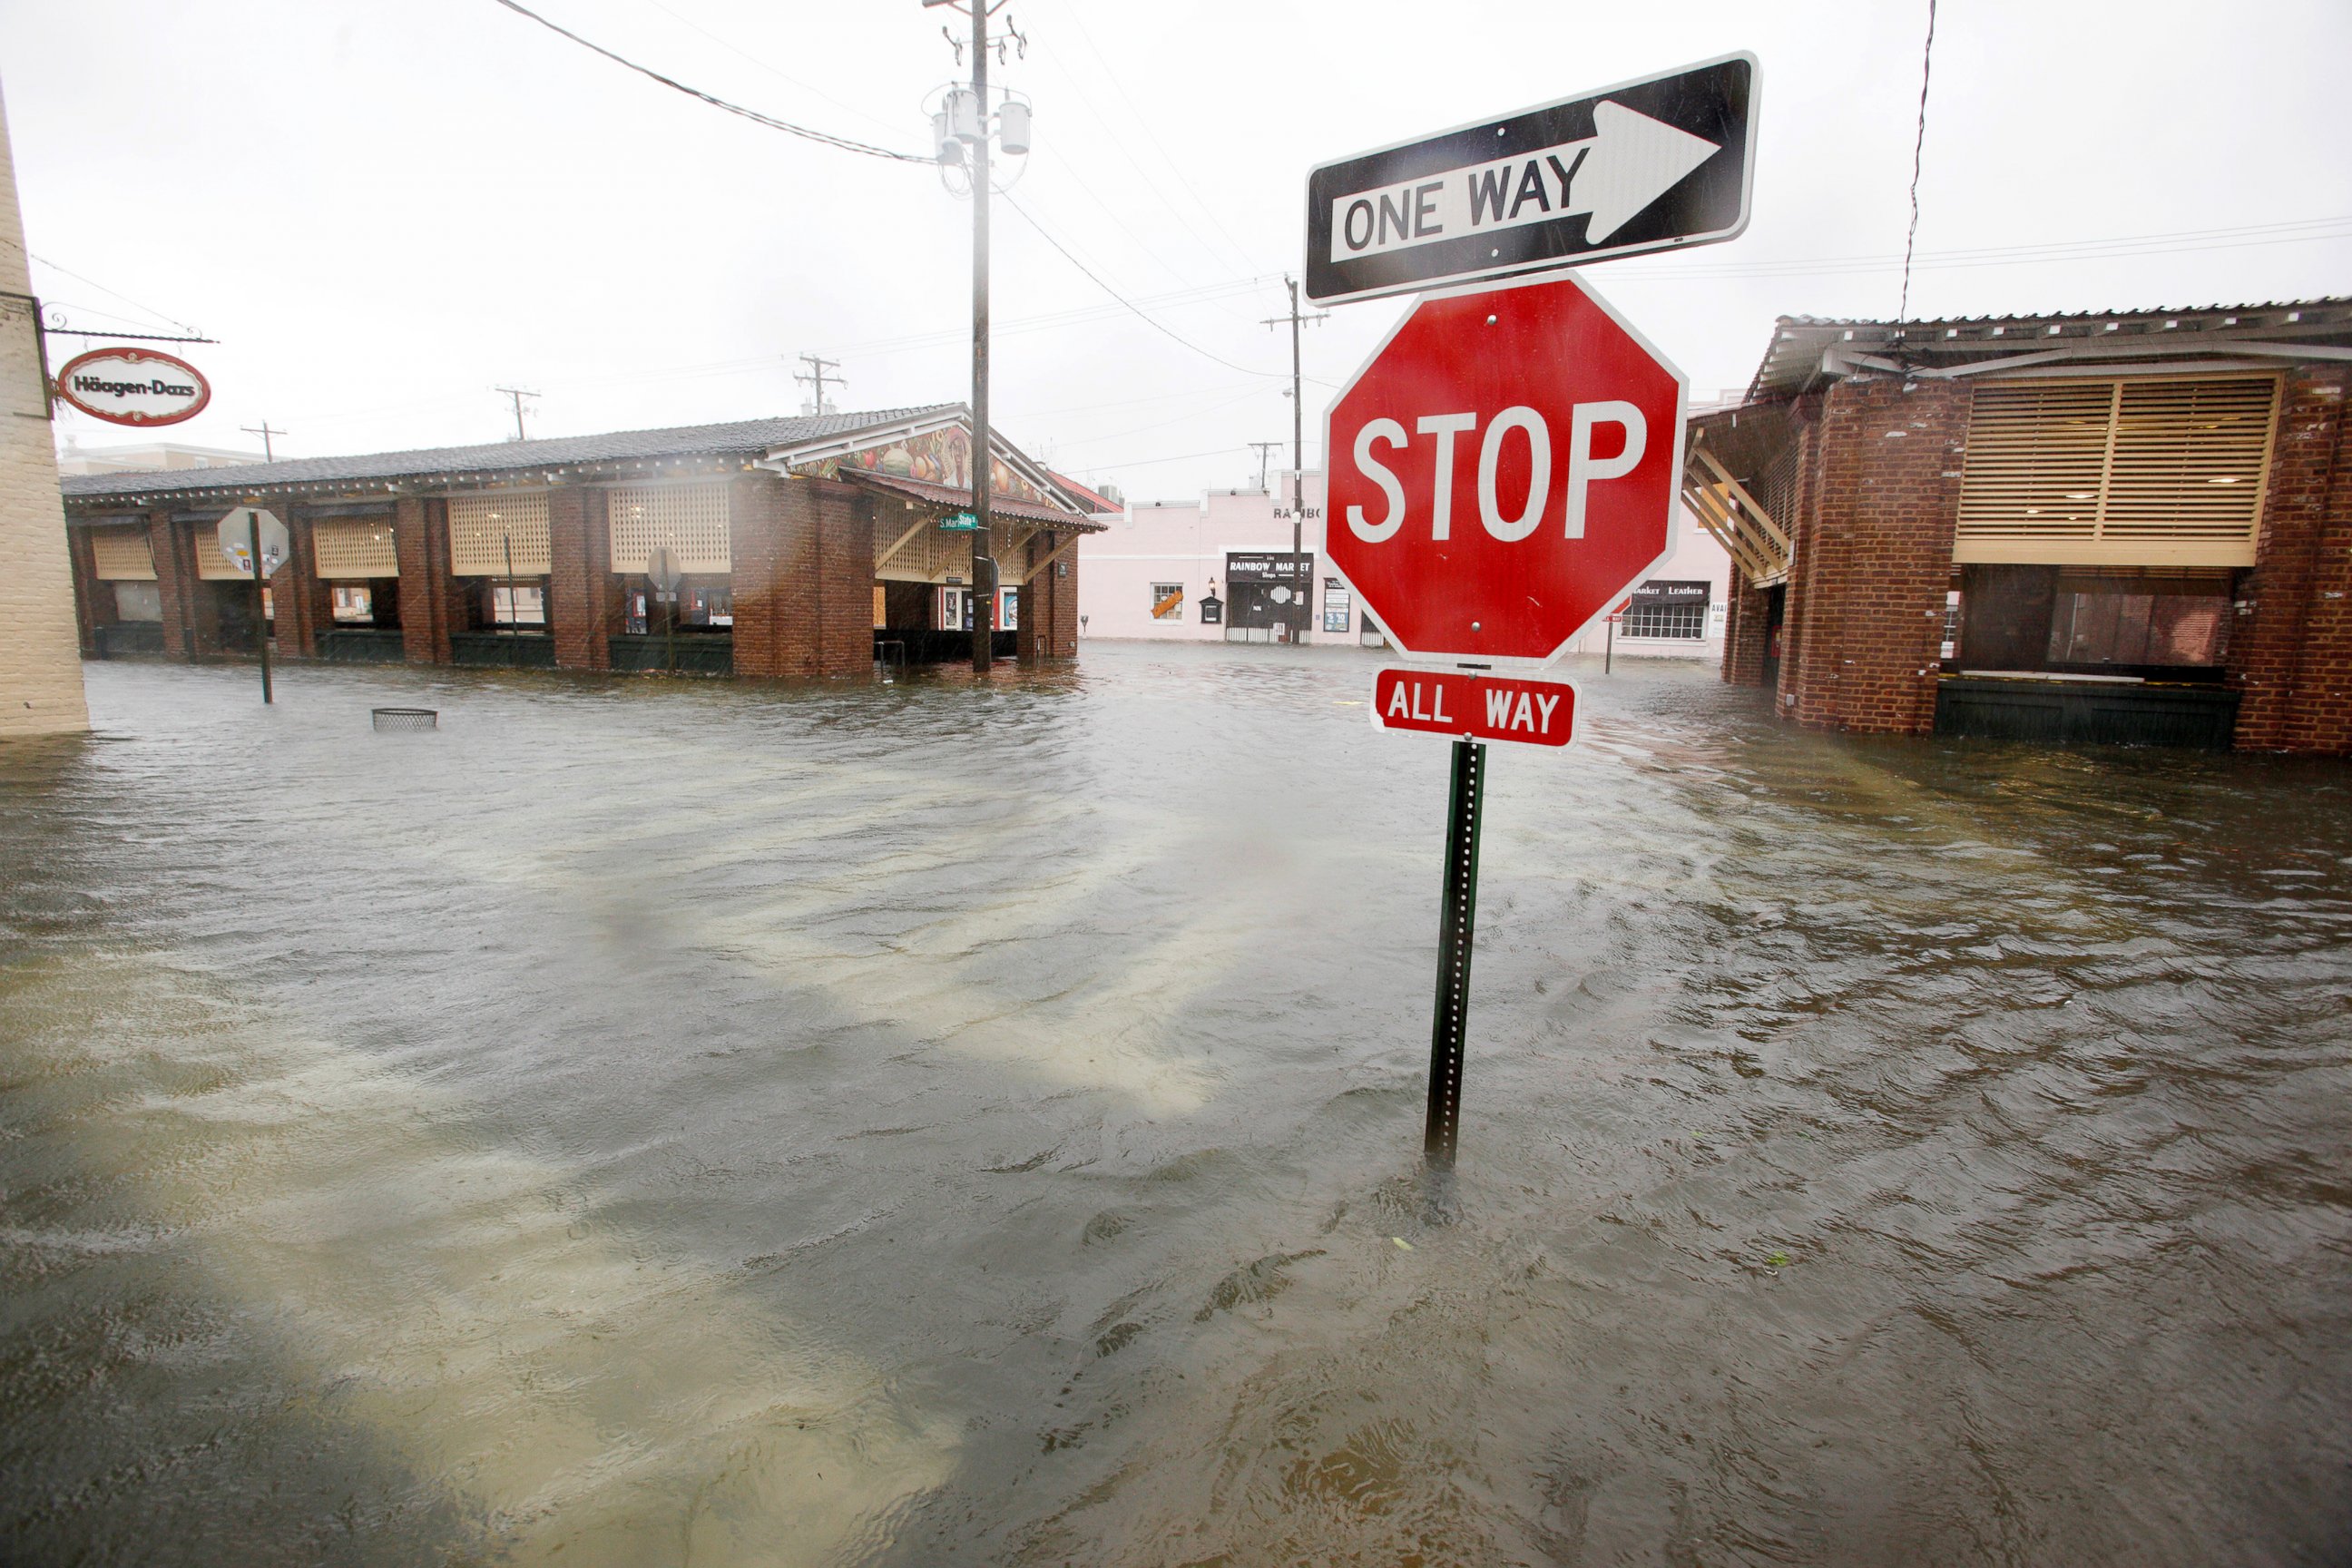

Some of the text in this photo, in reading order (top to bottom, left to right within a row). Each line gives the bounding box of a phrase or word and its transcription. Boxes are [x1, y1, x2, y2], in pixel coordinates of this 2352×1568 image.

[1345, 147, 1591, 251] ONE WAY
[74, 376, 195, 397] Häagen-Dazs
[1346, 400, 1647, 544] STOP
[946, 518, 959, 527] Mar
[958, 514, 972, 526] State
[1230, 562, 1310, 571] RAINBOW MARET
[1633, 586, 1660, 594] ARKET
[1711, 603, 1727, 612] AVAI
[1387, 681, 1560, 734] ALL WAY
